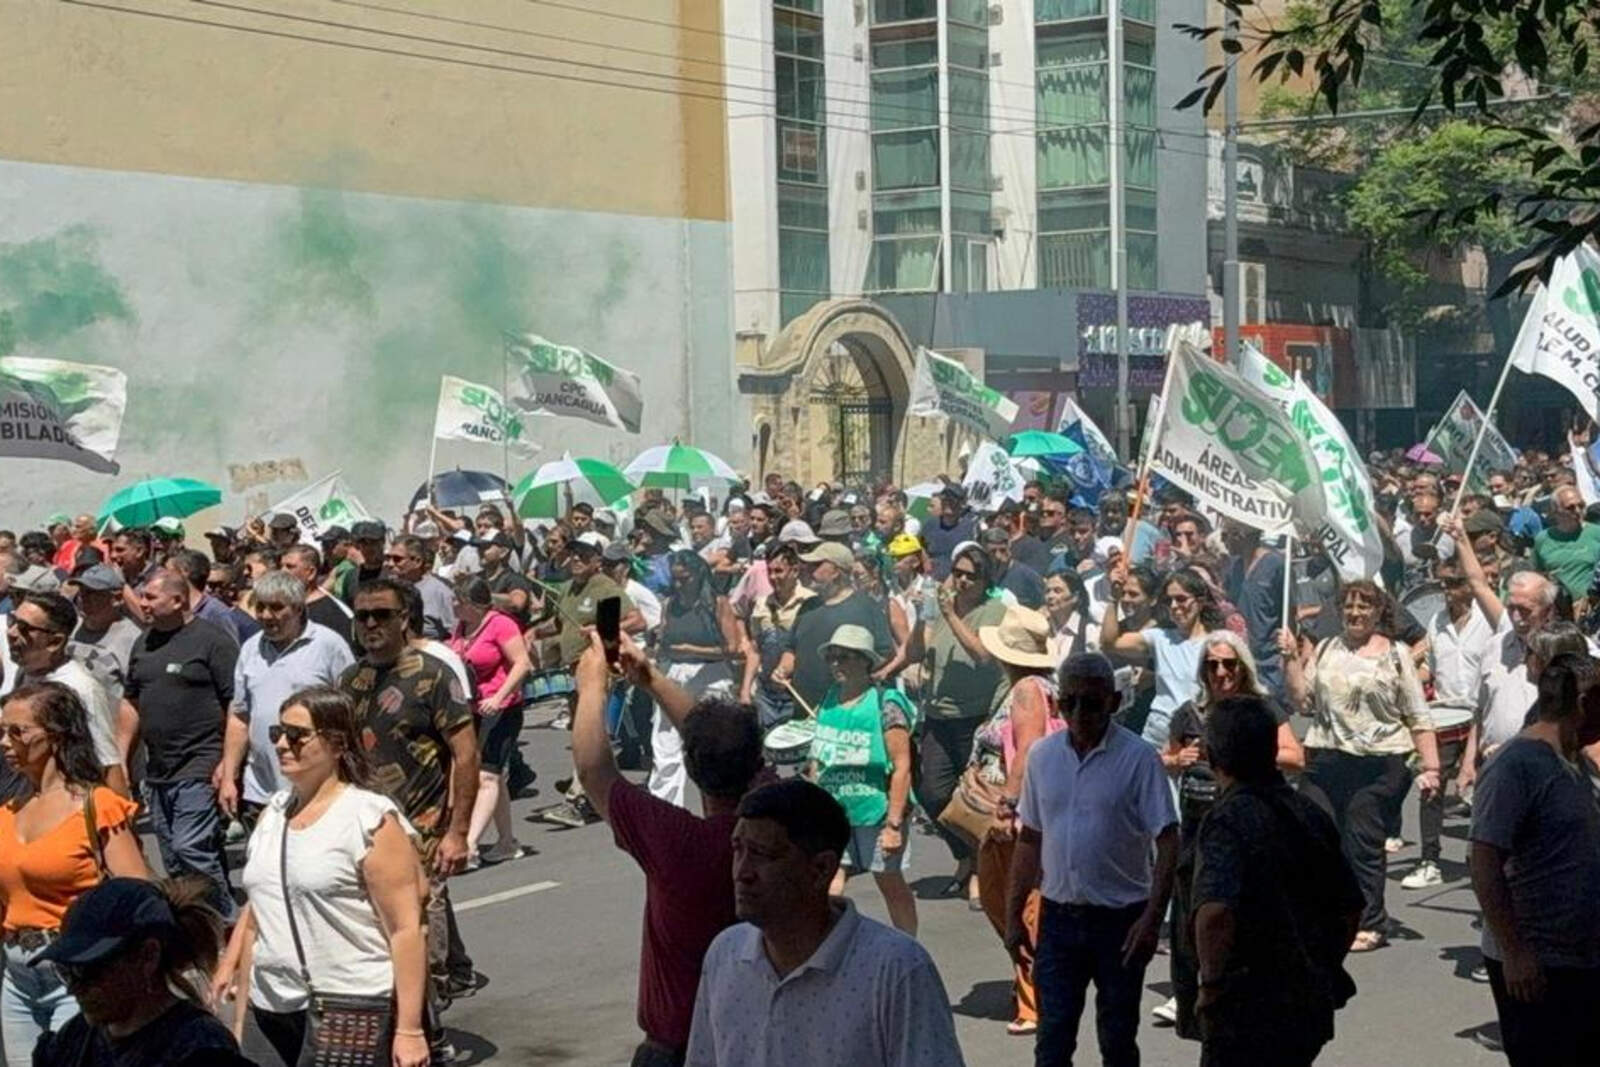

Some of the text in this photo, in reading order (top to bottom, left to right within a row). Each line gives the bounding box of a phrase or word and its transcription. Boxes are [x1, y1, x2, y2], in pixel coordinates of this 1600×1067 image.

[560, 381, 587, 397] CPC
[1181, 371, 1310, 494] SUOEM
[1198, 443, 1258, 490] ÁREAS
